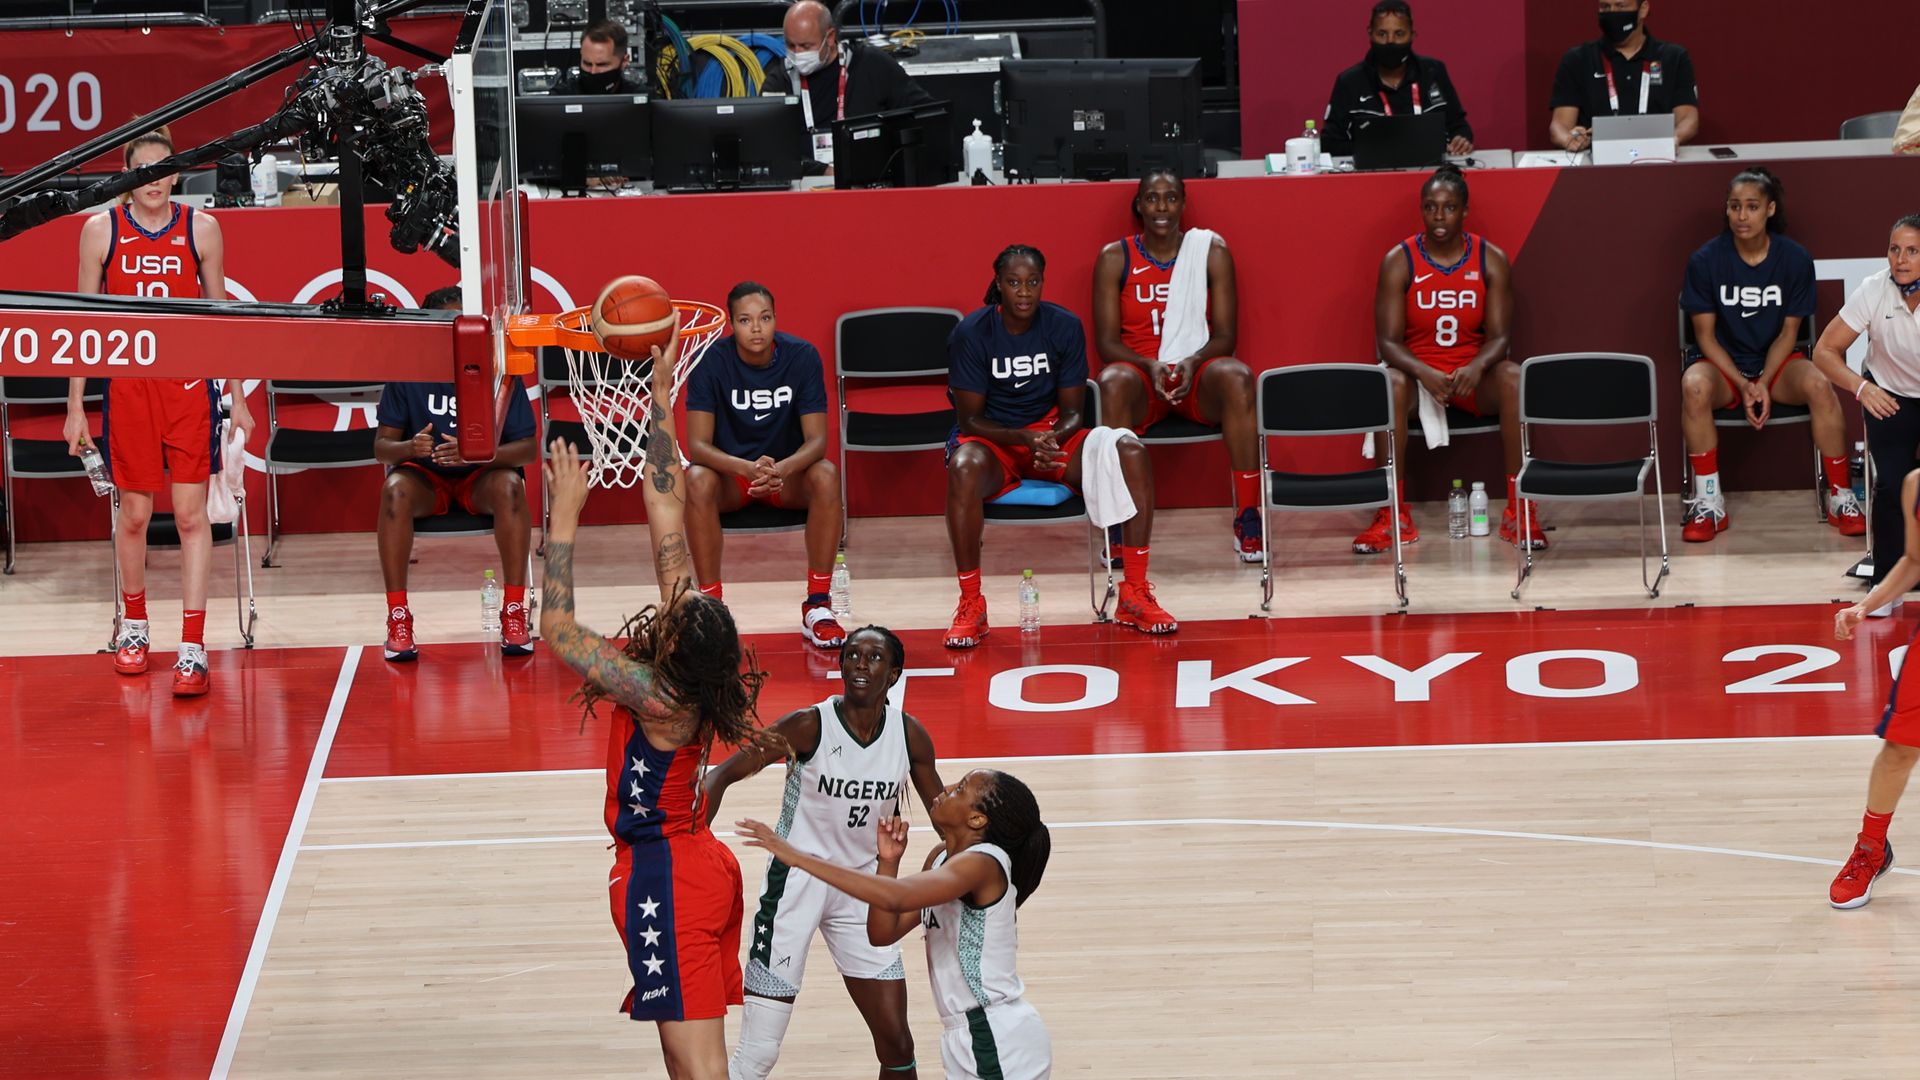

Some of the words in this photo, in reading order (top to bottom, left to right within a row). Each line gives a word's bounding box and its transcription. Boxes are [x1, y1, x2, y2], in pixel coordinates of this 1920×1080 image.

[121, 254, 182, 275] USA
[1416, 289, 1477, 310] USA
[1720, 284, 1783, 307] USA
[1435, 314, 1458, 348] 8
[51, 328, 157, 366] 2020
[991, 352, 1050, 379] USA
[731, 385, 793, 411] USA
[1721, 644, 1910, 695] 2
[847, 804, 871, 828] 52
[641, 985, 670, 1002] USA
